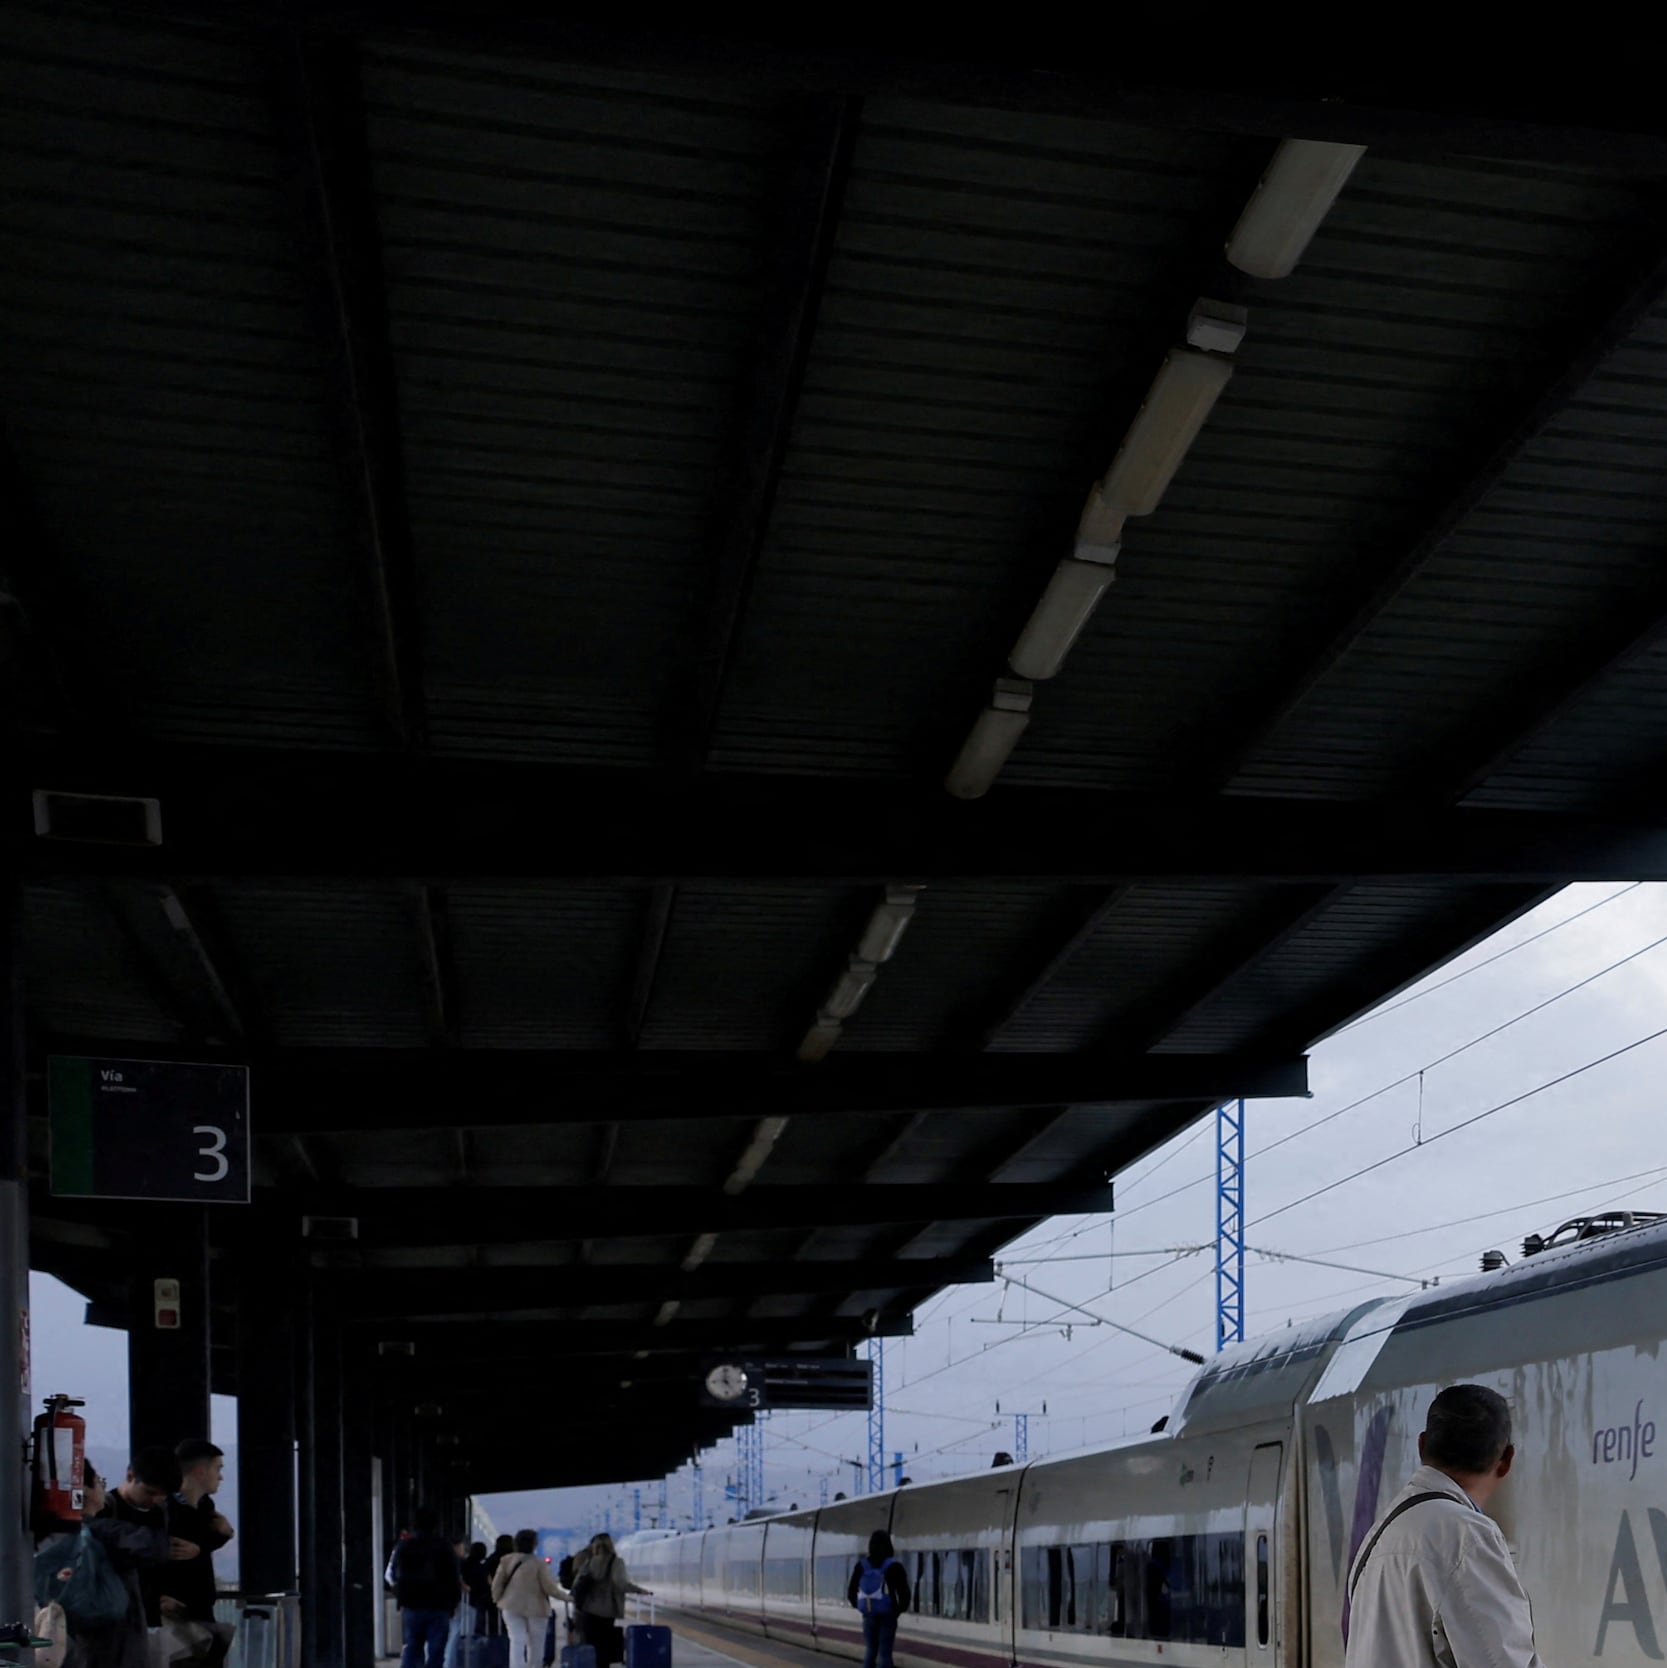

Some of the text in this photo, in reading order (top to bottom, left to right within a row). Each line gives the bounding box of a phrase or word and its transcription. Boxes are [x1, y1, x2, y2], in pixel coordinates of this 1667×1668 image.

[100, 1068, 123, 1082] Vía
[192, 1125, 229, 1182] 3
[748, 1387, 760, 1407] 3
[1592, 1398, 1656, 1481] renfe
